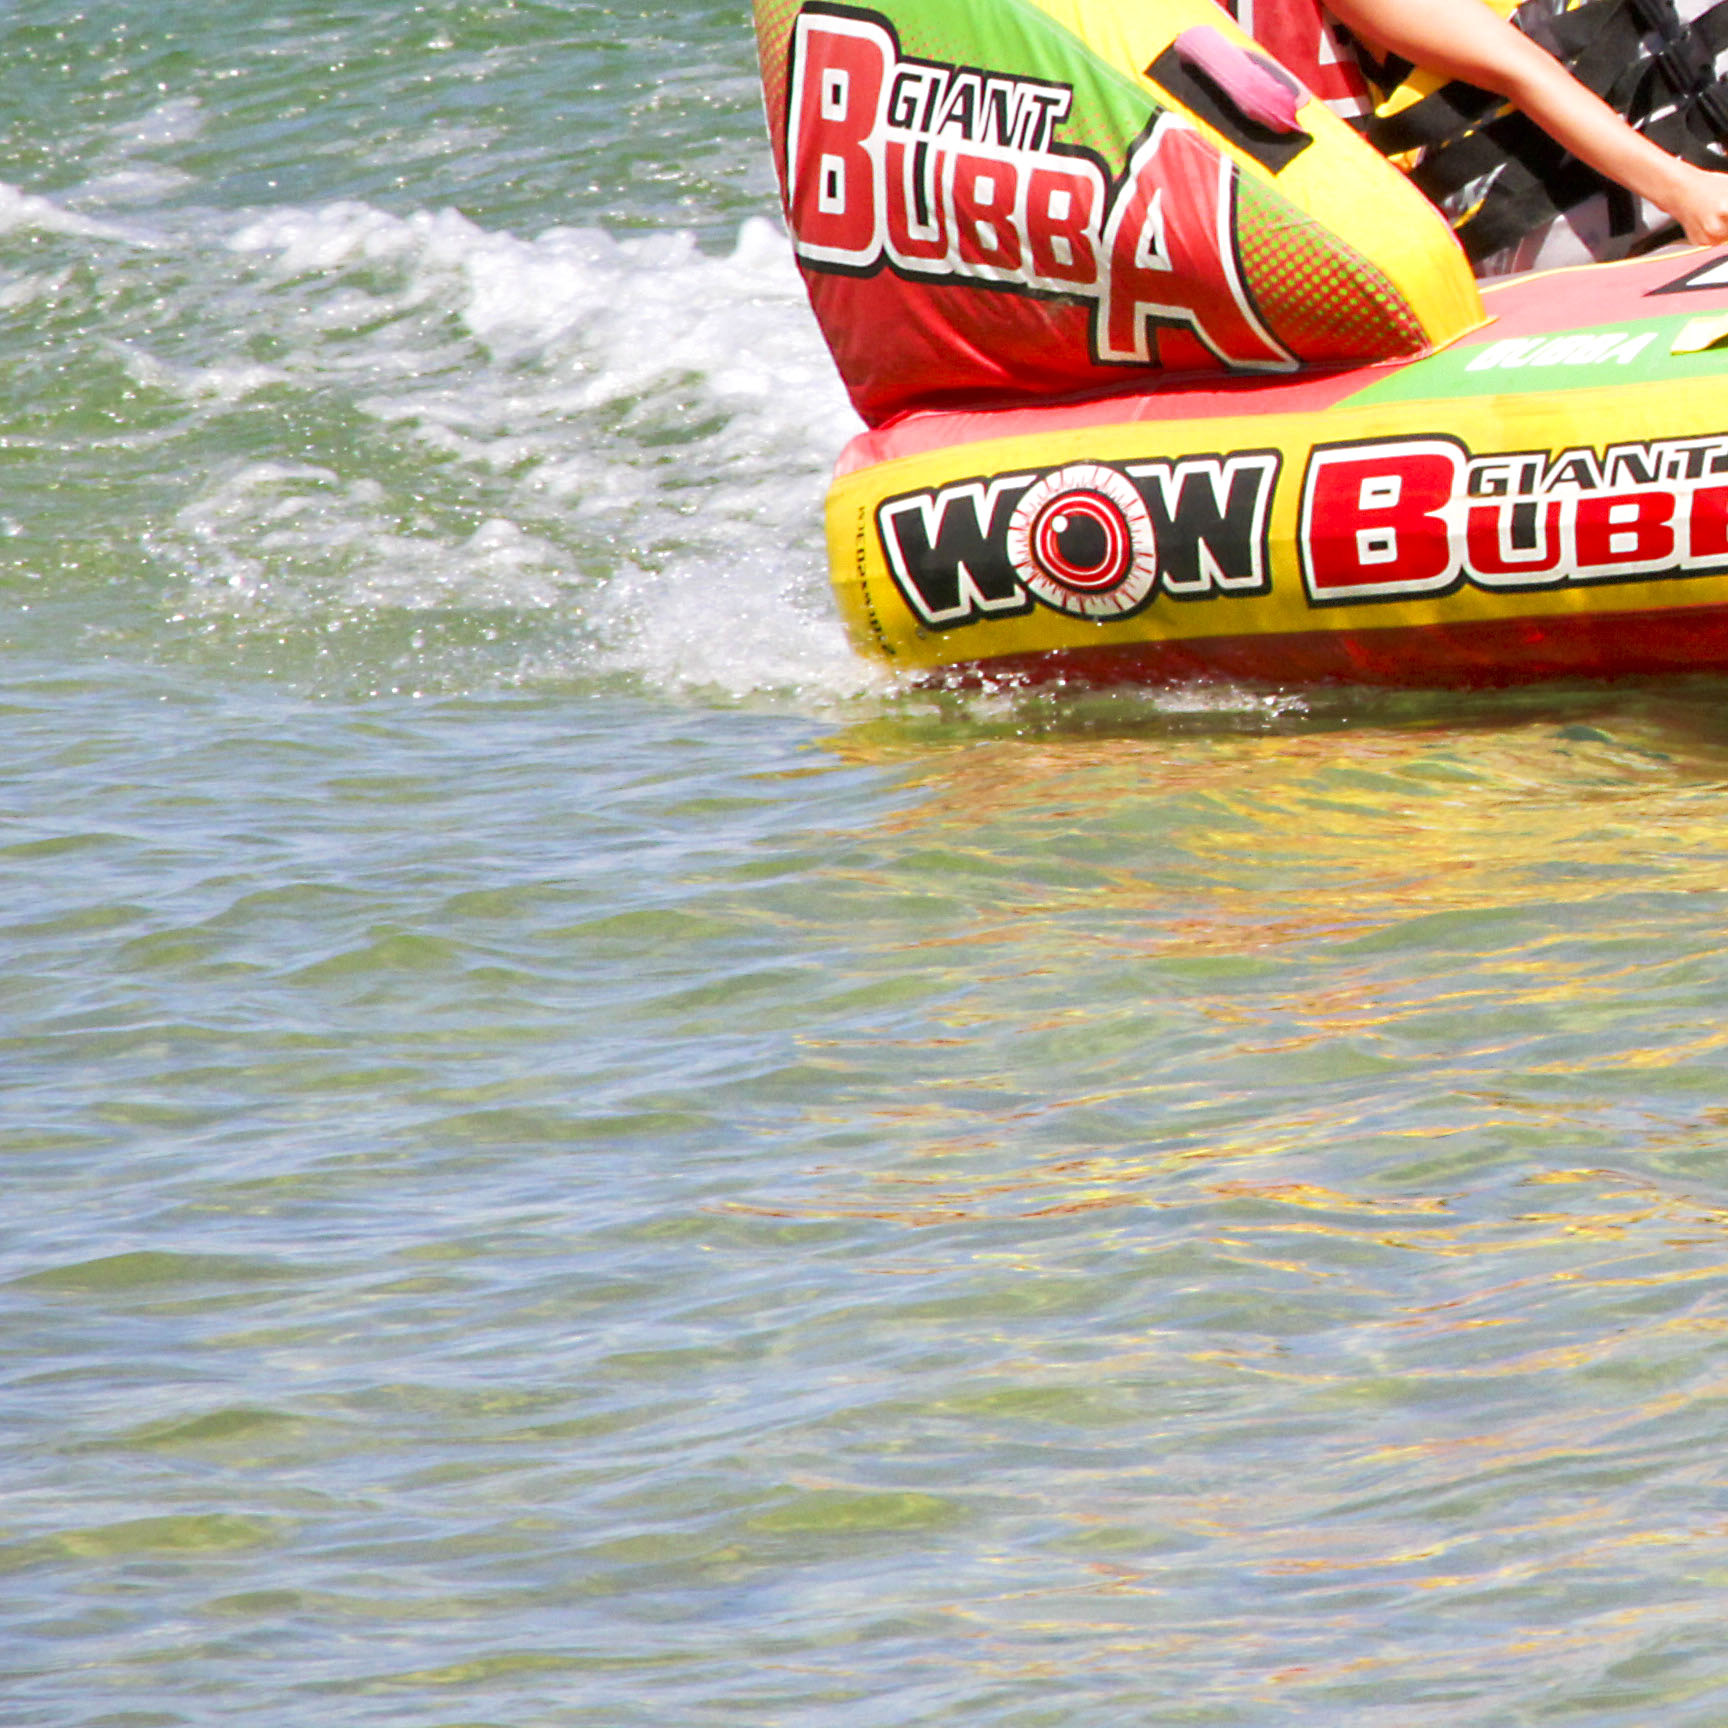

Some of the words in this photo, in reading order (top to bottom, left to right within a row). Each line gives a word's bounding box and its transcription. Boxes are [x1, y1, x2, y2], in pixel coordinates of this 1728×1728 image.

[886, 60, 1072, 153] GIANT
[785, 12, 1300, 373] BUBBA
[876, 452, 1281, 621] WOW
